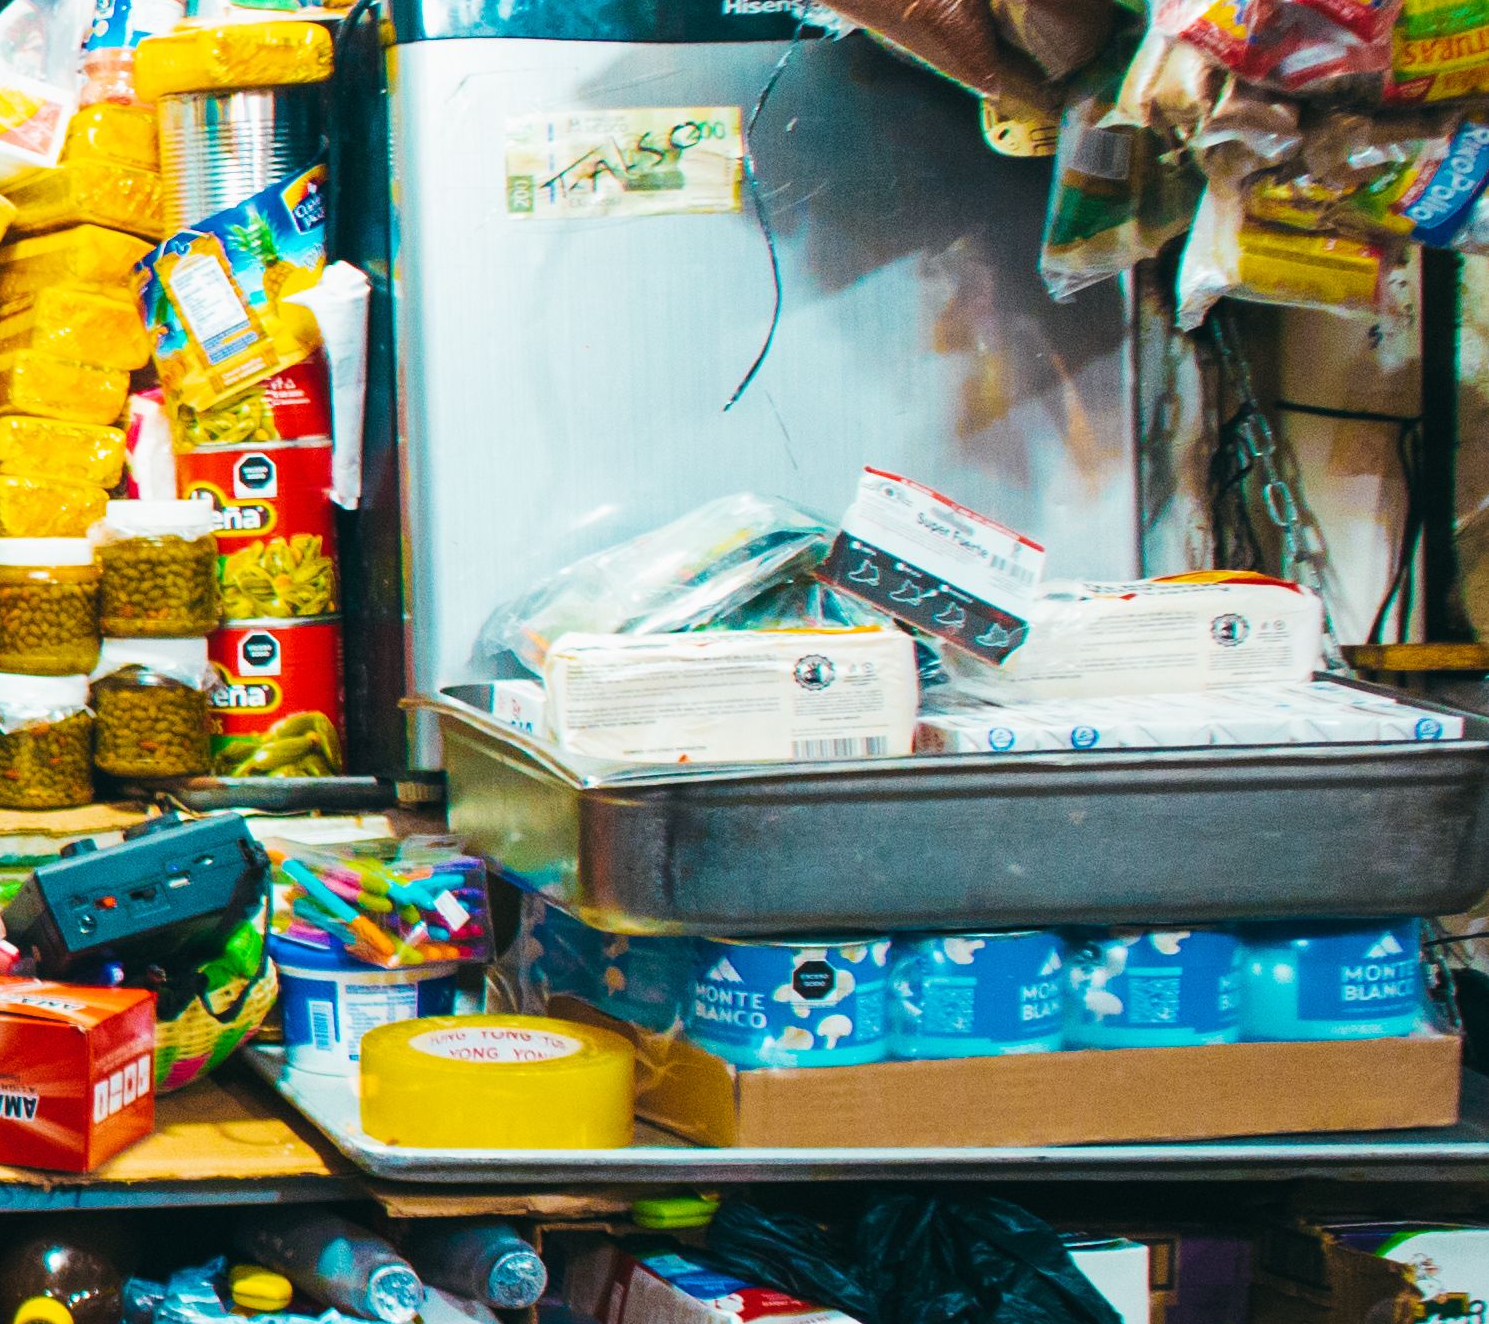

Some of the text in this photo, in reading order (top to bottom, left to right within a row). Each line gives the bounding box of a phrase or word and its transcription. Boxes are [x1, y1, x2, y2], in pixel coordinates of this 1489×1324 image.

[685, 120, 727, 143] 200
[949, 527, 990, 563] Fuerte
[1342, 962, 1416, 986] MONTE
[694, 985, 765, 1011] MONTE
[694, 1003, 767, 1031] BLANCO
